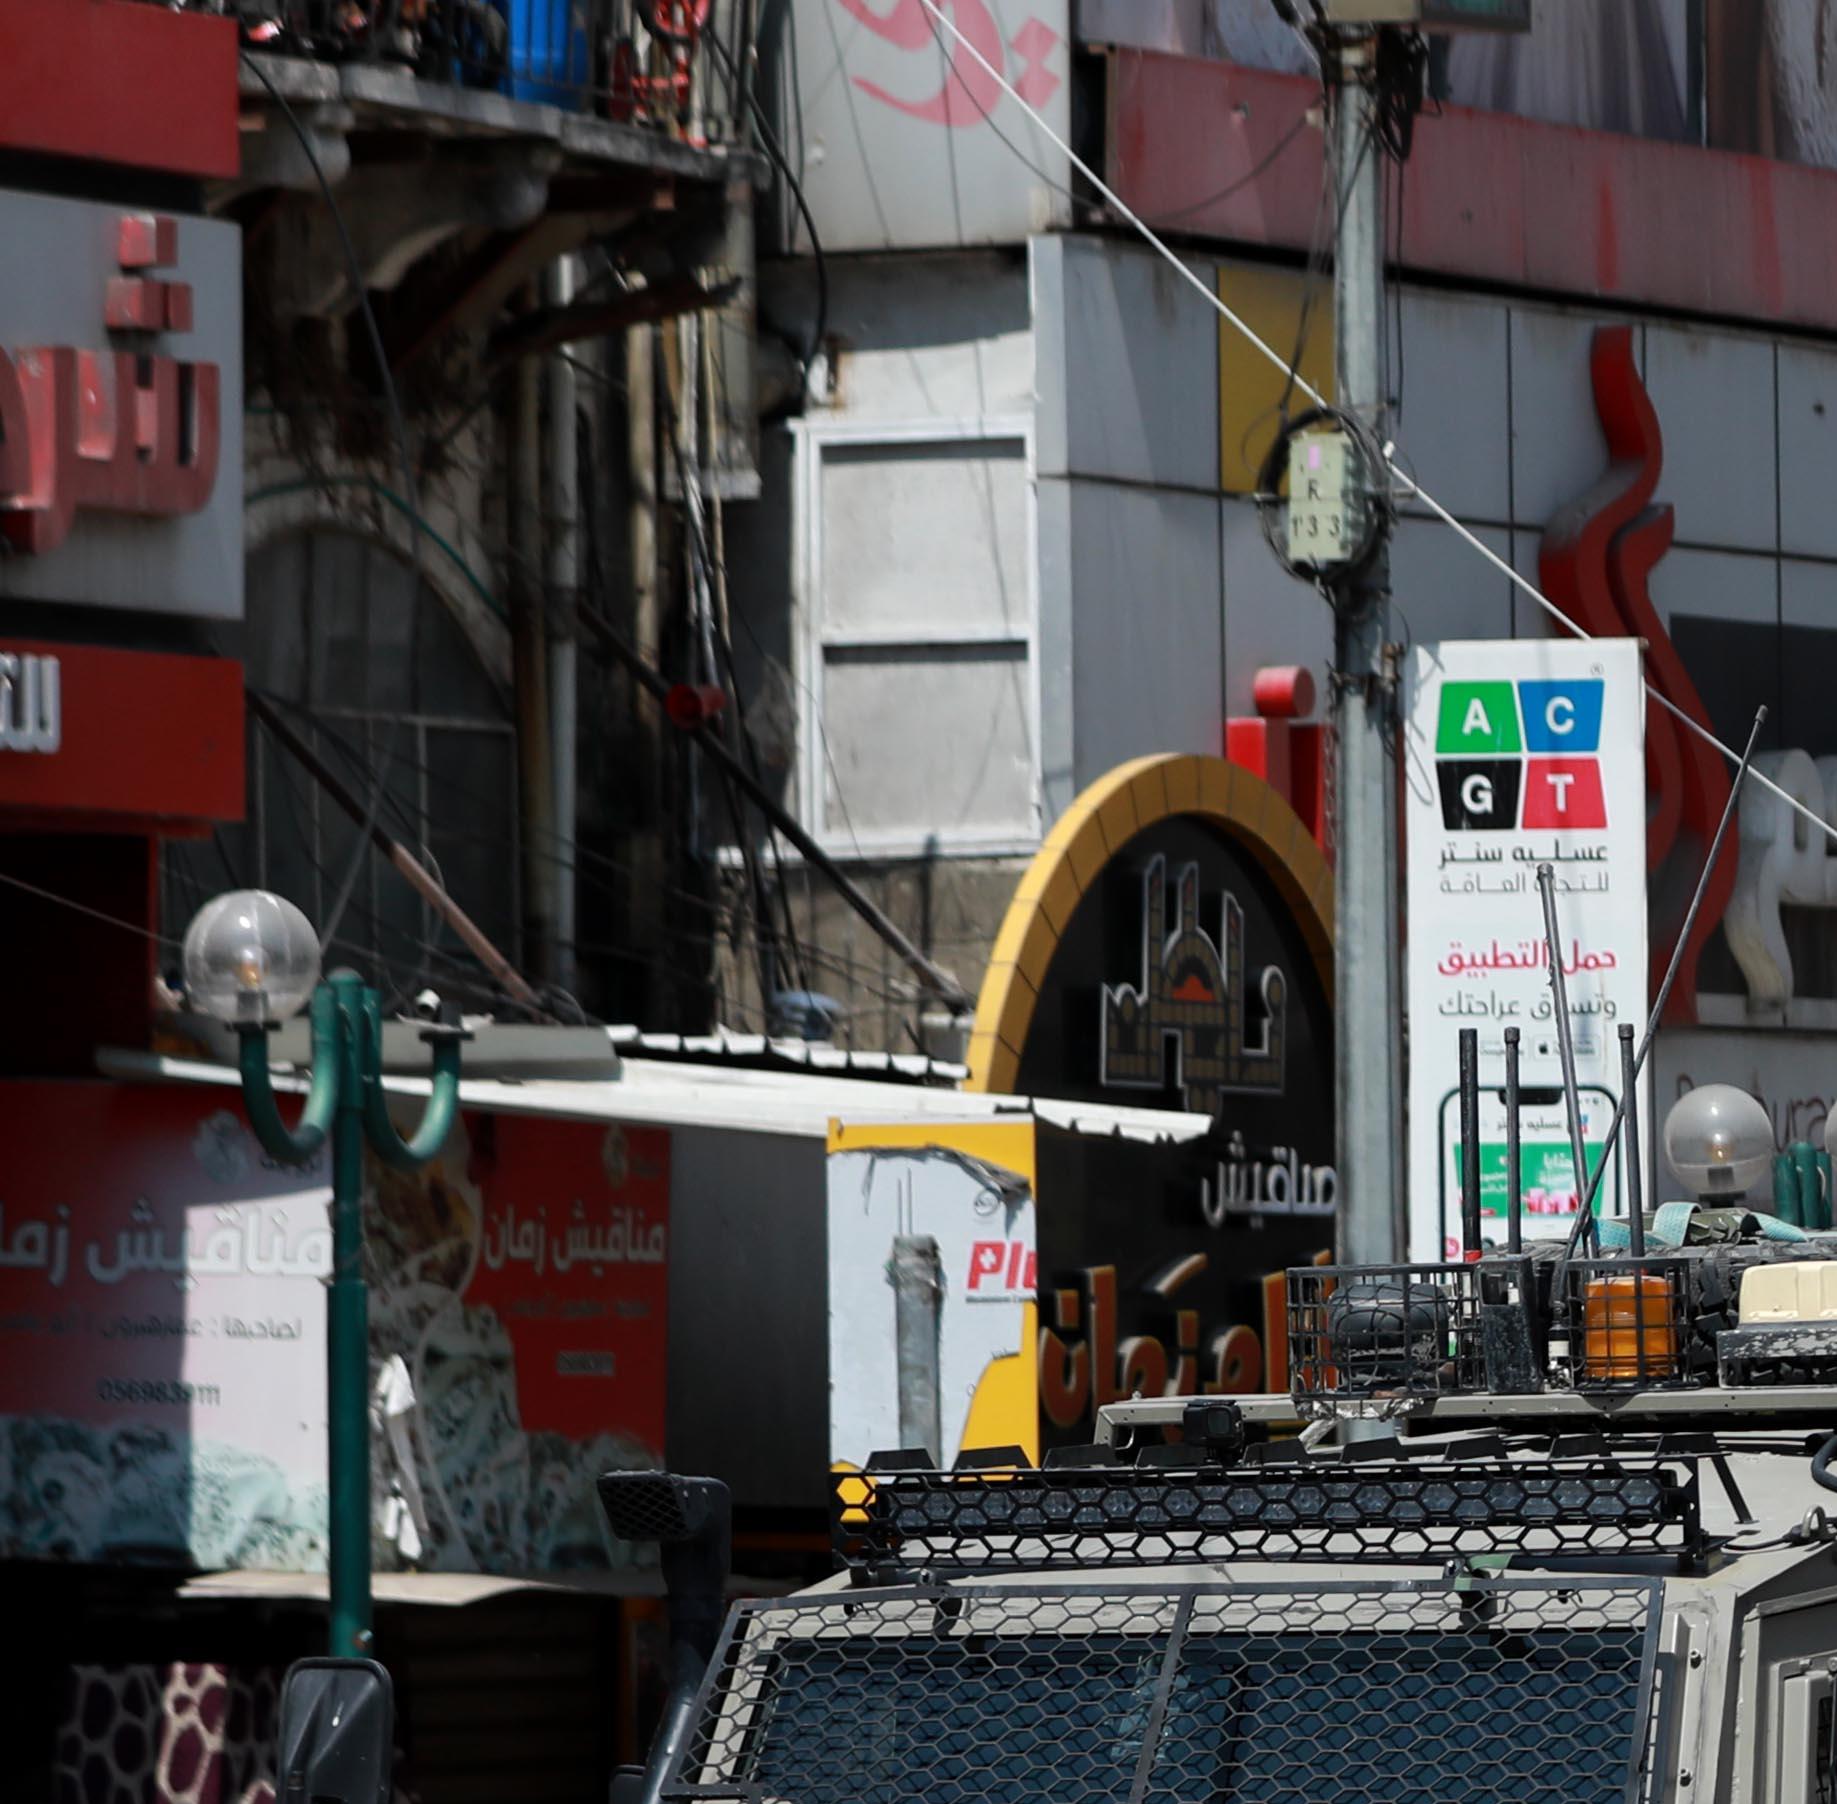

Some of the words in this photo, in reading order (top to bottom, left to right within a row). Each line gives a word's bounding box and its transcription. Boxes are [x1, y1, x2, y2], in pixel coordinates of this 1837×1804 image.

[1461, 697, 1492, 736] A
[1545, 695, 1576, 735] C
[1461, 773, 1494, 815] G
[1546, 772, 1576, 814] T
[1437, 938, 1550, 978] التطبيق
[483, 1202, 547, 1277] زمان
[551, 1199, 666, 1278] مناقيش
[966, 1240, 1038, 1291] Pl
